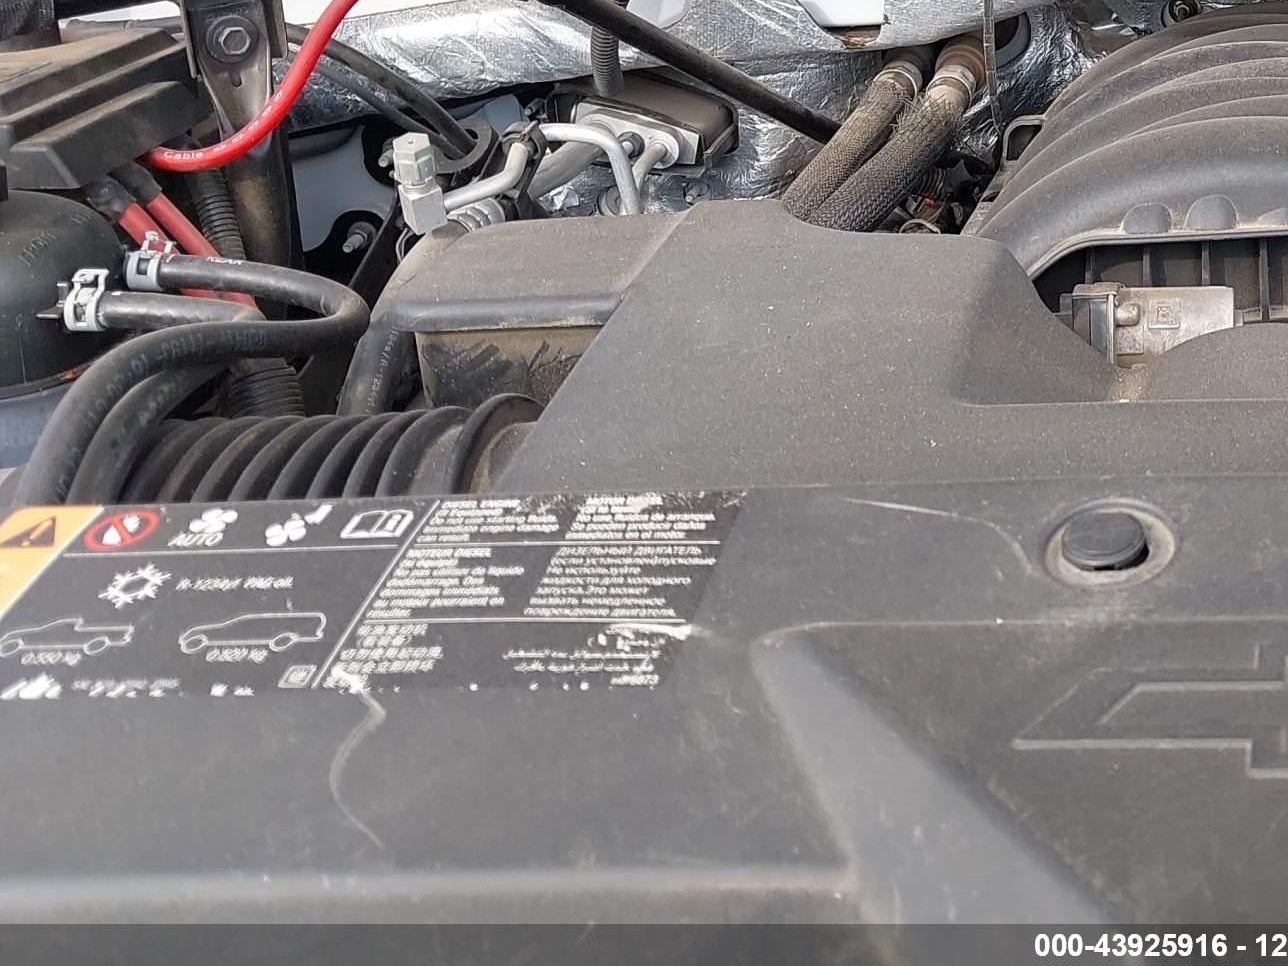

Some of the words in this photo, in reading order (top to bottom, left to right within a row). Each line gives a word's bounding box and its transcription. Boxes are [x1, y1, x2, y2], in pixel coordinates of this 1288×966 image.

[163, 149, 204, 161] Cable
[442, 500, 478, 508] DIESEL
[586, 497, 625, 505] MOTOR
[486, 516, 526, 524] starting
[576, 514, 591, 522] No
[592, 514, 612, 522] use
[614, 514, 649, 522] fluidos
[423, 525, 478, 534] Immediate
[480, 525, 516, 533] engine
[517, 524, 559, 533] damage
[586, 523, 626, 531] pueden
[627, 522, 672, 531] producir
[167, 533, 224, 547] AUTO
[416, 535, 437, 543] can
[565, 532, 623, 540] inmediatos
[406, 548, 453, 558] MOTEUR
[454, 548, 491, 557] DIESEL
[558, 546, 633, 556] ДИЗЕЛЬНЫЙ
[634, 546, 702, 556] ДВИГАТЕЛЬ
[551, 557, 583, 566] (если
[393, 568, 409, 577] Ne
[410, 569, 431, 577] pas
[432, 568, 470, 576] utiliser
[472, 567, 486, 576] de
[487, 566, 524, 576] liquide
[546, 566, 563, 575] Не
[564, 566, 641, 575] используйте
[463, 577, 484, 585] Des
[540, 576, 600, 585] жидкости
[601, 576, 625, 585] для
[626, 576, 691, 586] холодного
[379, 587, 441, 597] dommages
[609, 587, 648, 595] может
[373, 599, 388, 607] au
[390, 598, 429, 607] moteur
[430, 597, 488, 607] pourraient
[489, 597, 505, 606] en
[529, 597, 580, 605] вызвать
[582, 597, 666, 606] немедленное
[523, 607, 610, 617] повреждение
